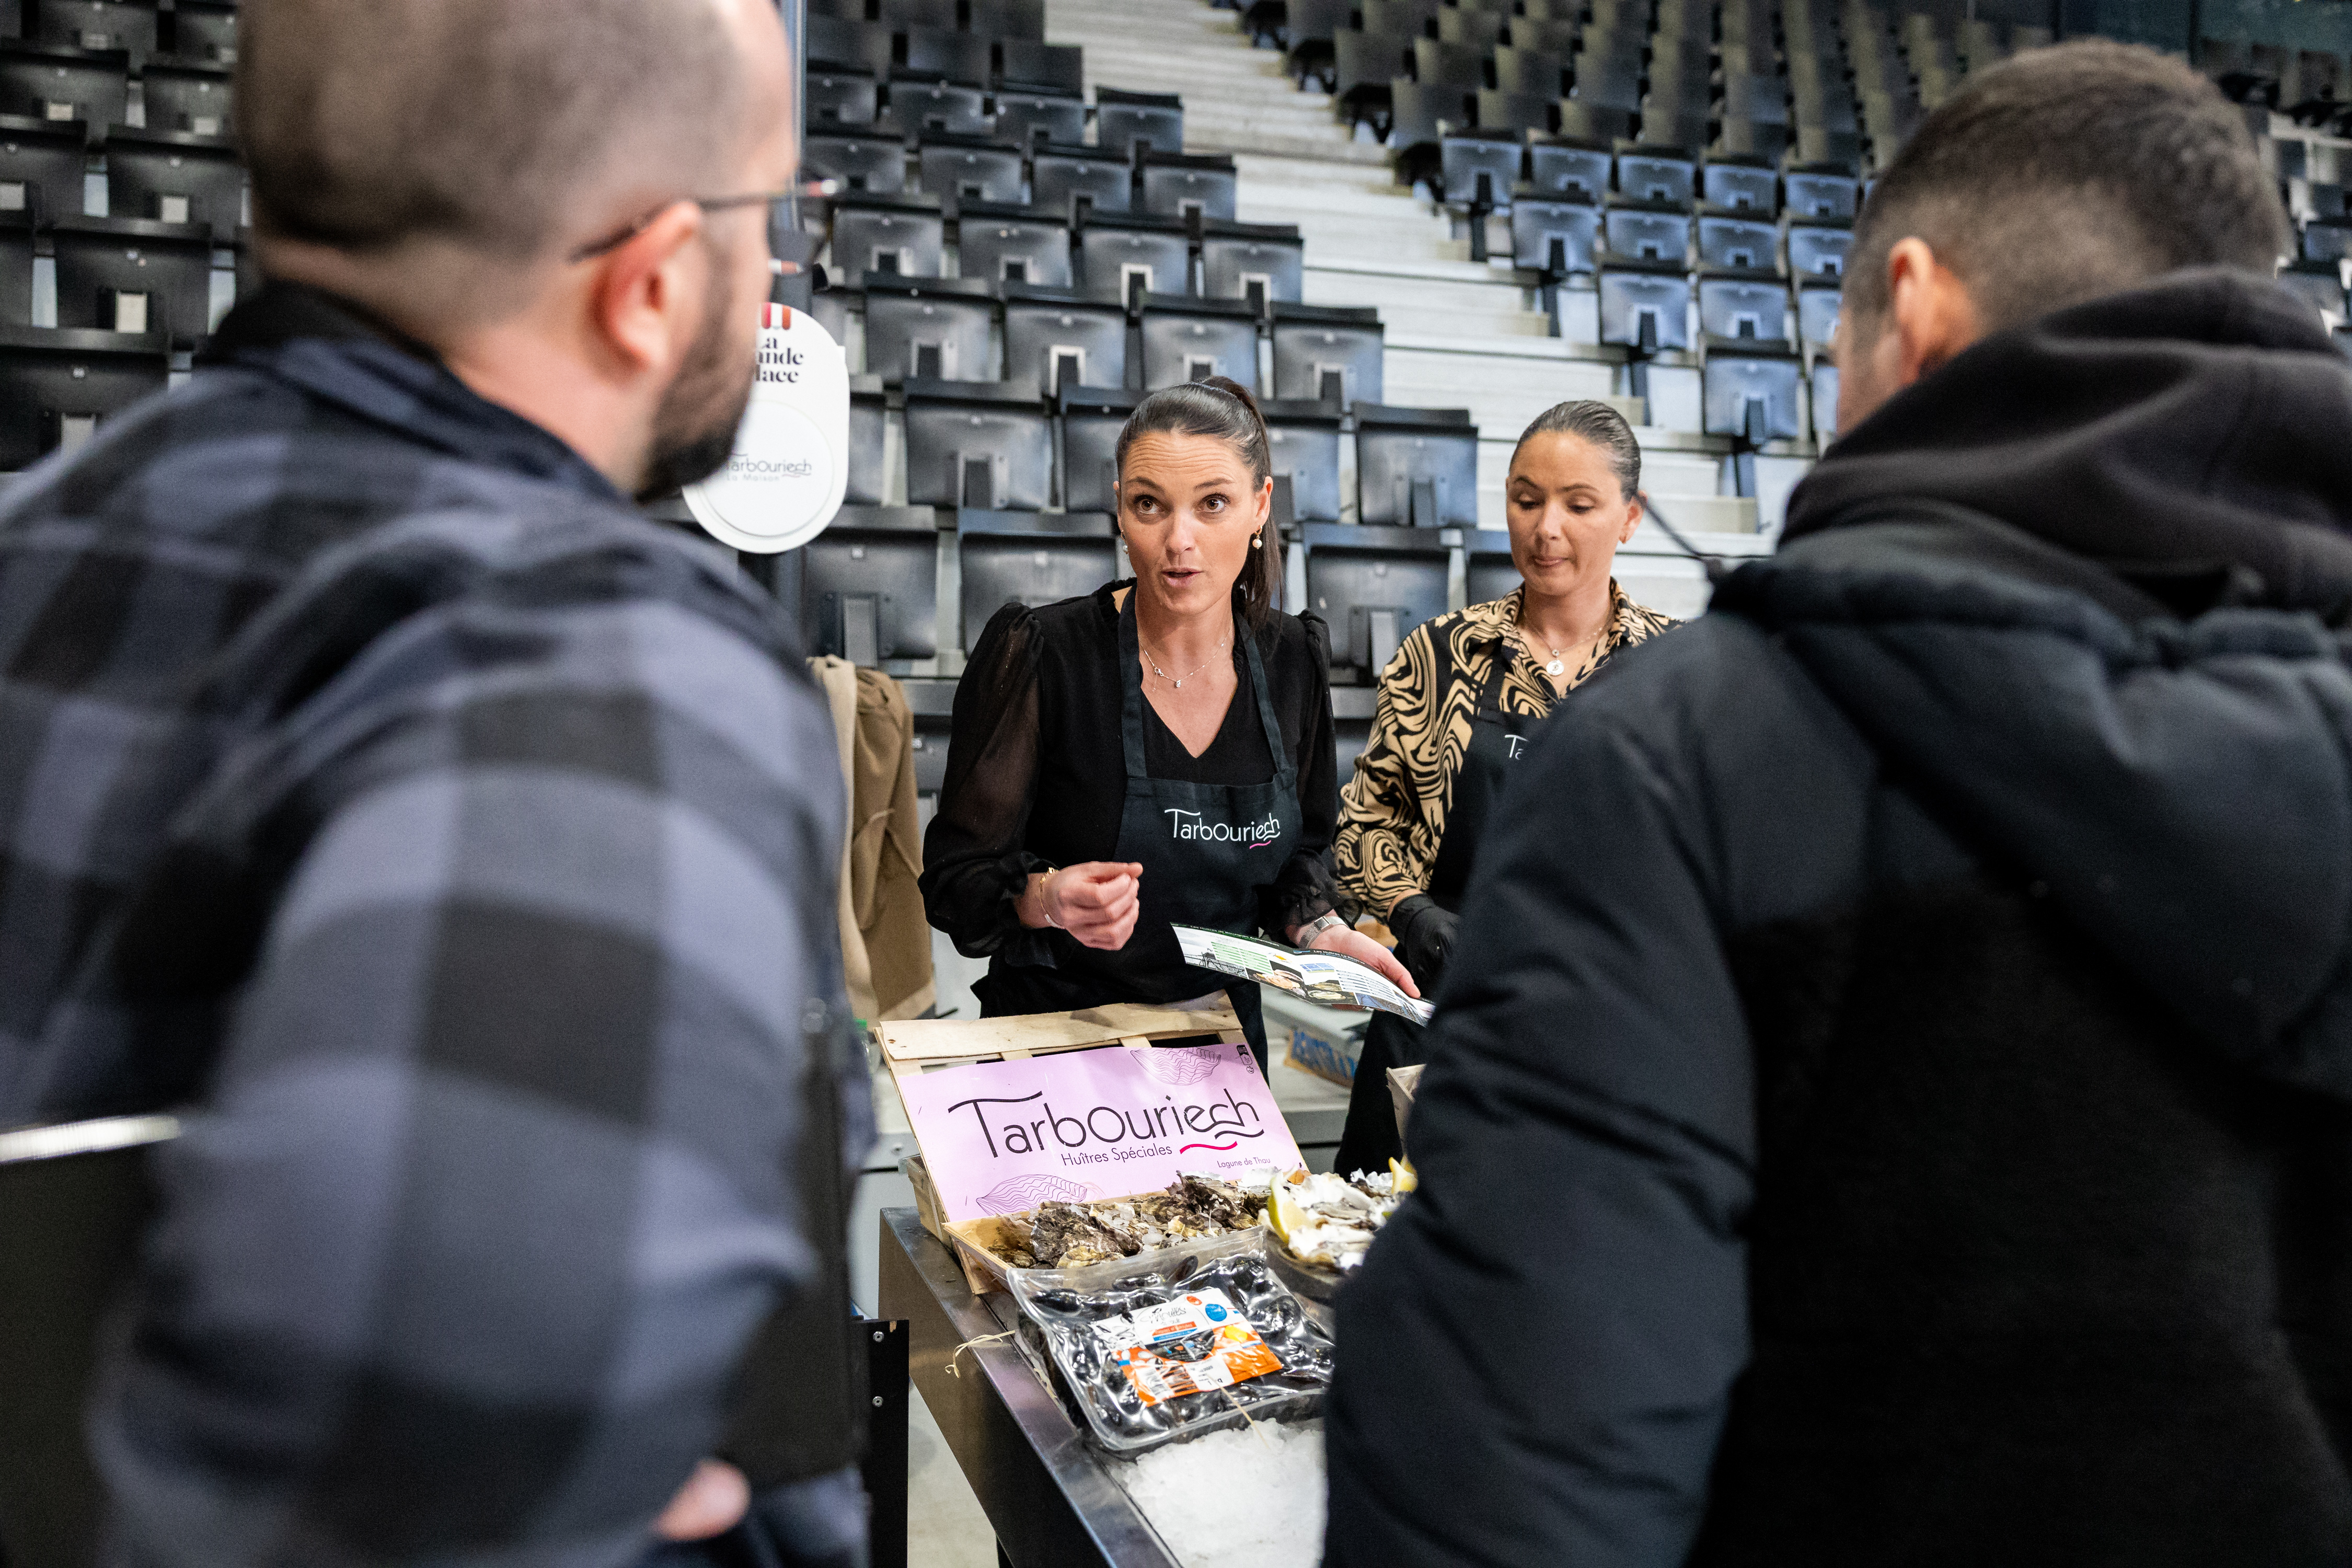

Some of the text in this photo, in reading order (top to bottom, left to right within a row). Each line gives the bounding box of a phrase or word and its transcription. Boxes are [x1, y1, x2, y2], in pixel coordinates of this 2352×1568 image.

[756, 364, 799, 383] lace
[1061, 1143, 1172, 1166] Huîtres Spéciales
[1217, 1160, 1242, 1169] Lagune
[1253, 1156, 1271, 1165] Thau
